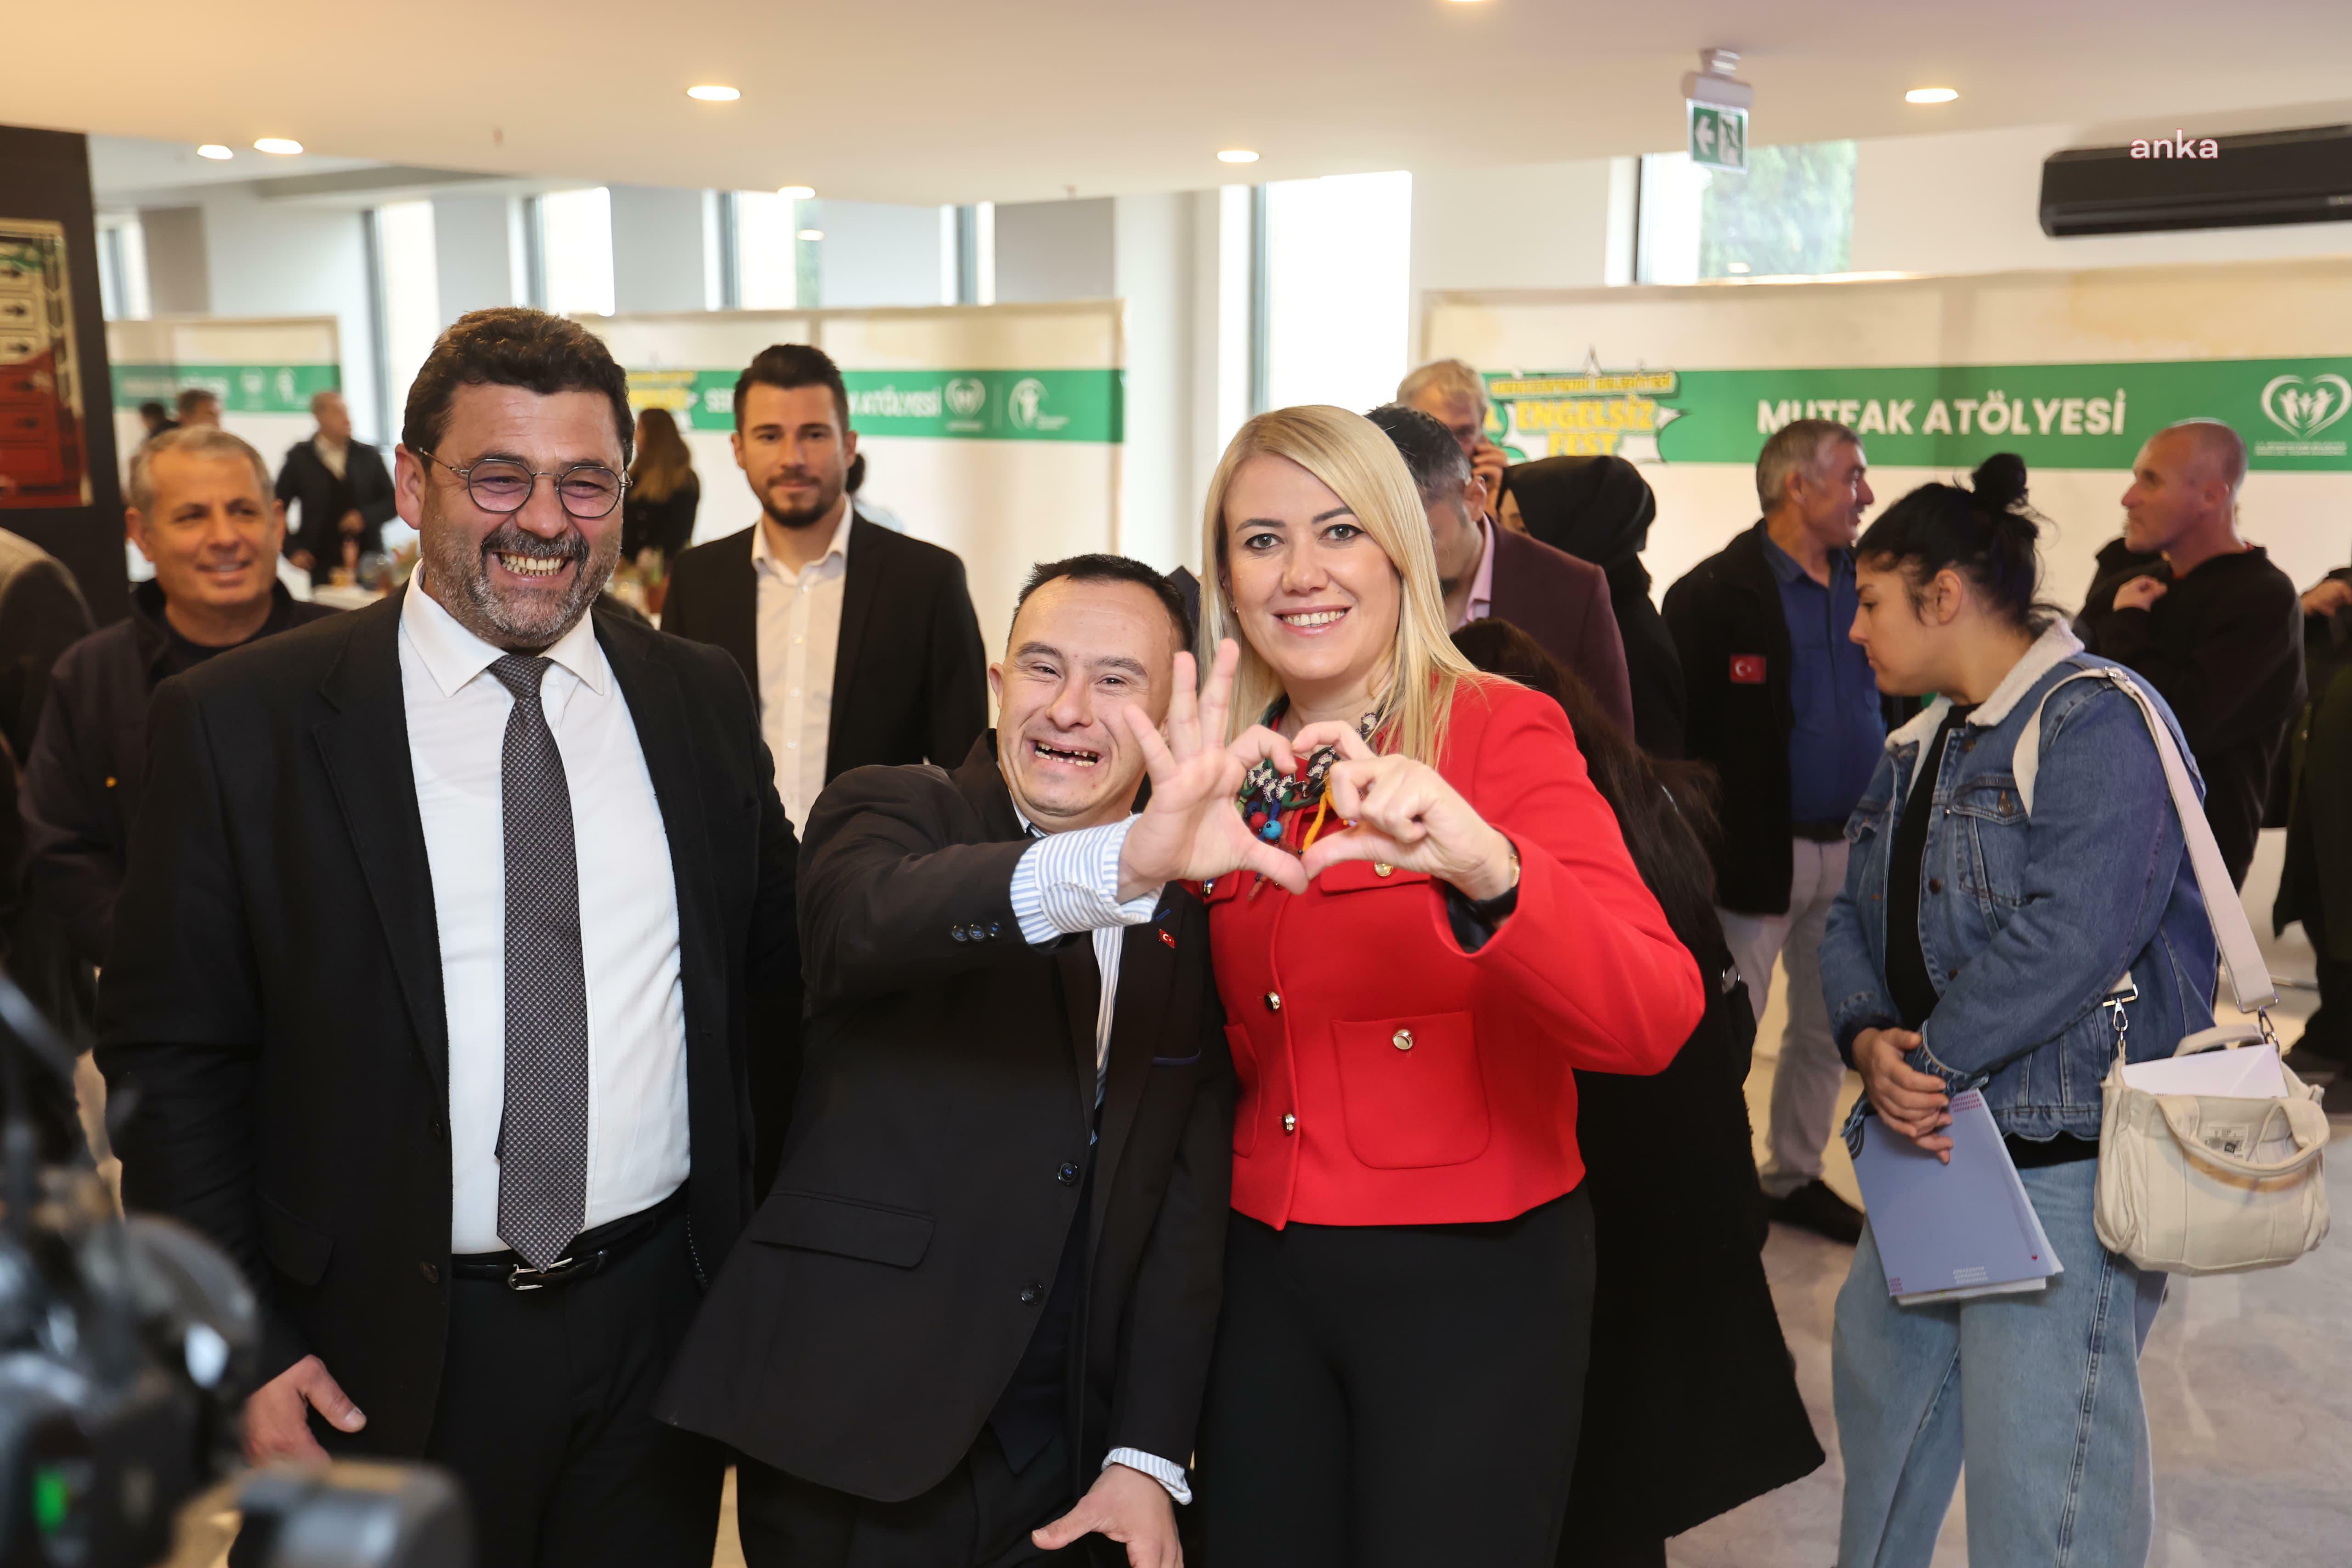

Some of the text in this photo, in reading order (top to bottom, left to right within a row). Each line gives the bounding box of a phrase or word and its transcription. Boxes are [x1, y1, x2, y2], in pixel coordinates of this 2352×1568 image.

[1517, 394, 1654, 430] ENGELSİZ
[1757, 388, 2126, 435] MUTFAK ATÖLYESİ
[1549, 433, 1617, 456] FEST
